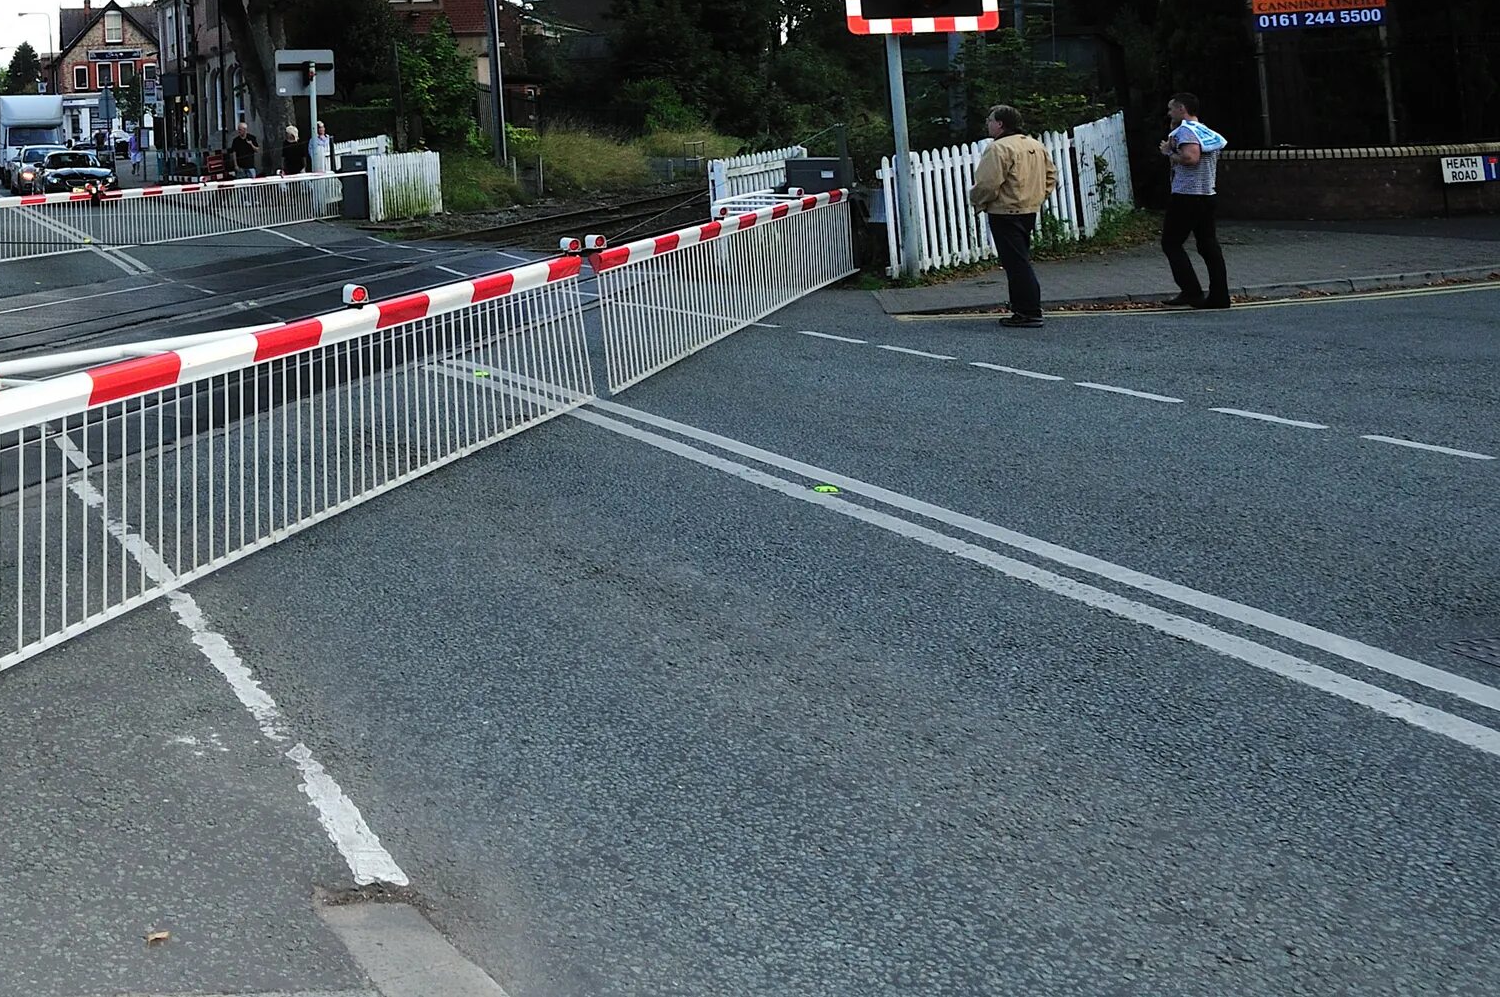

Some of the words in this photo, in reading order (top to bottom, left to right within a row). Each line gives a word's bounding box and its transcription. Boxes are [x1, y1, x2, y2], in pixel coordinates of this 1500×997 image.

[1259, 14, 1298, 28] 0161
[1304, 11, 1336, 25] 244
[1340, 8, 1382, 23] 5500
[1446, 158, 1478, 169] HEATH
[1452, 170, 1478, 181] ROAD
